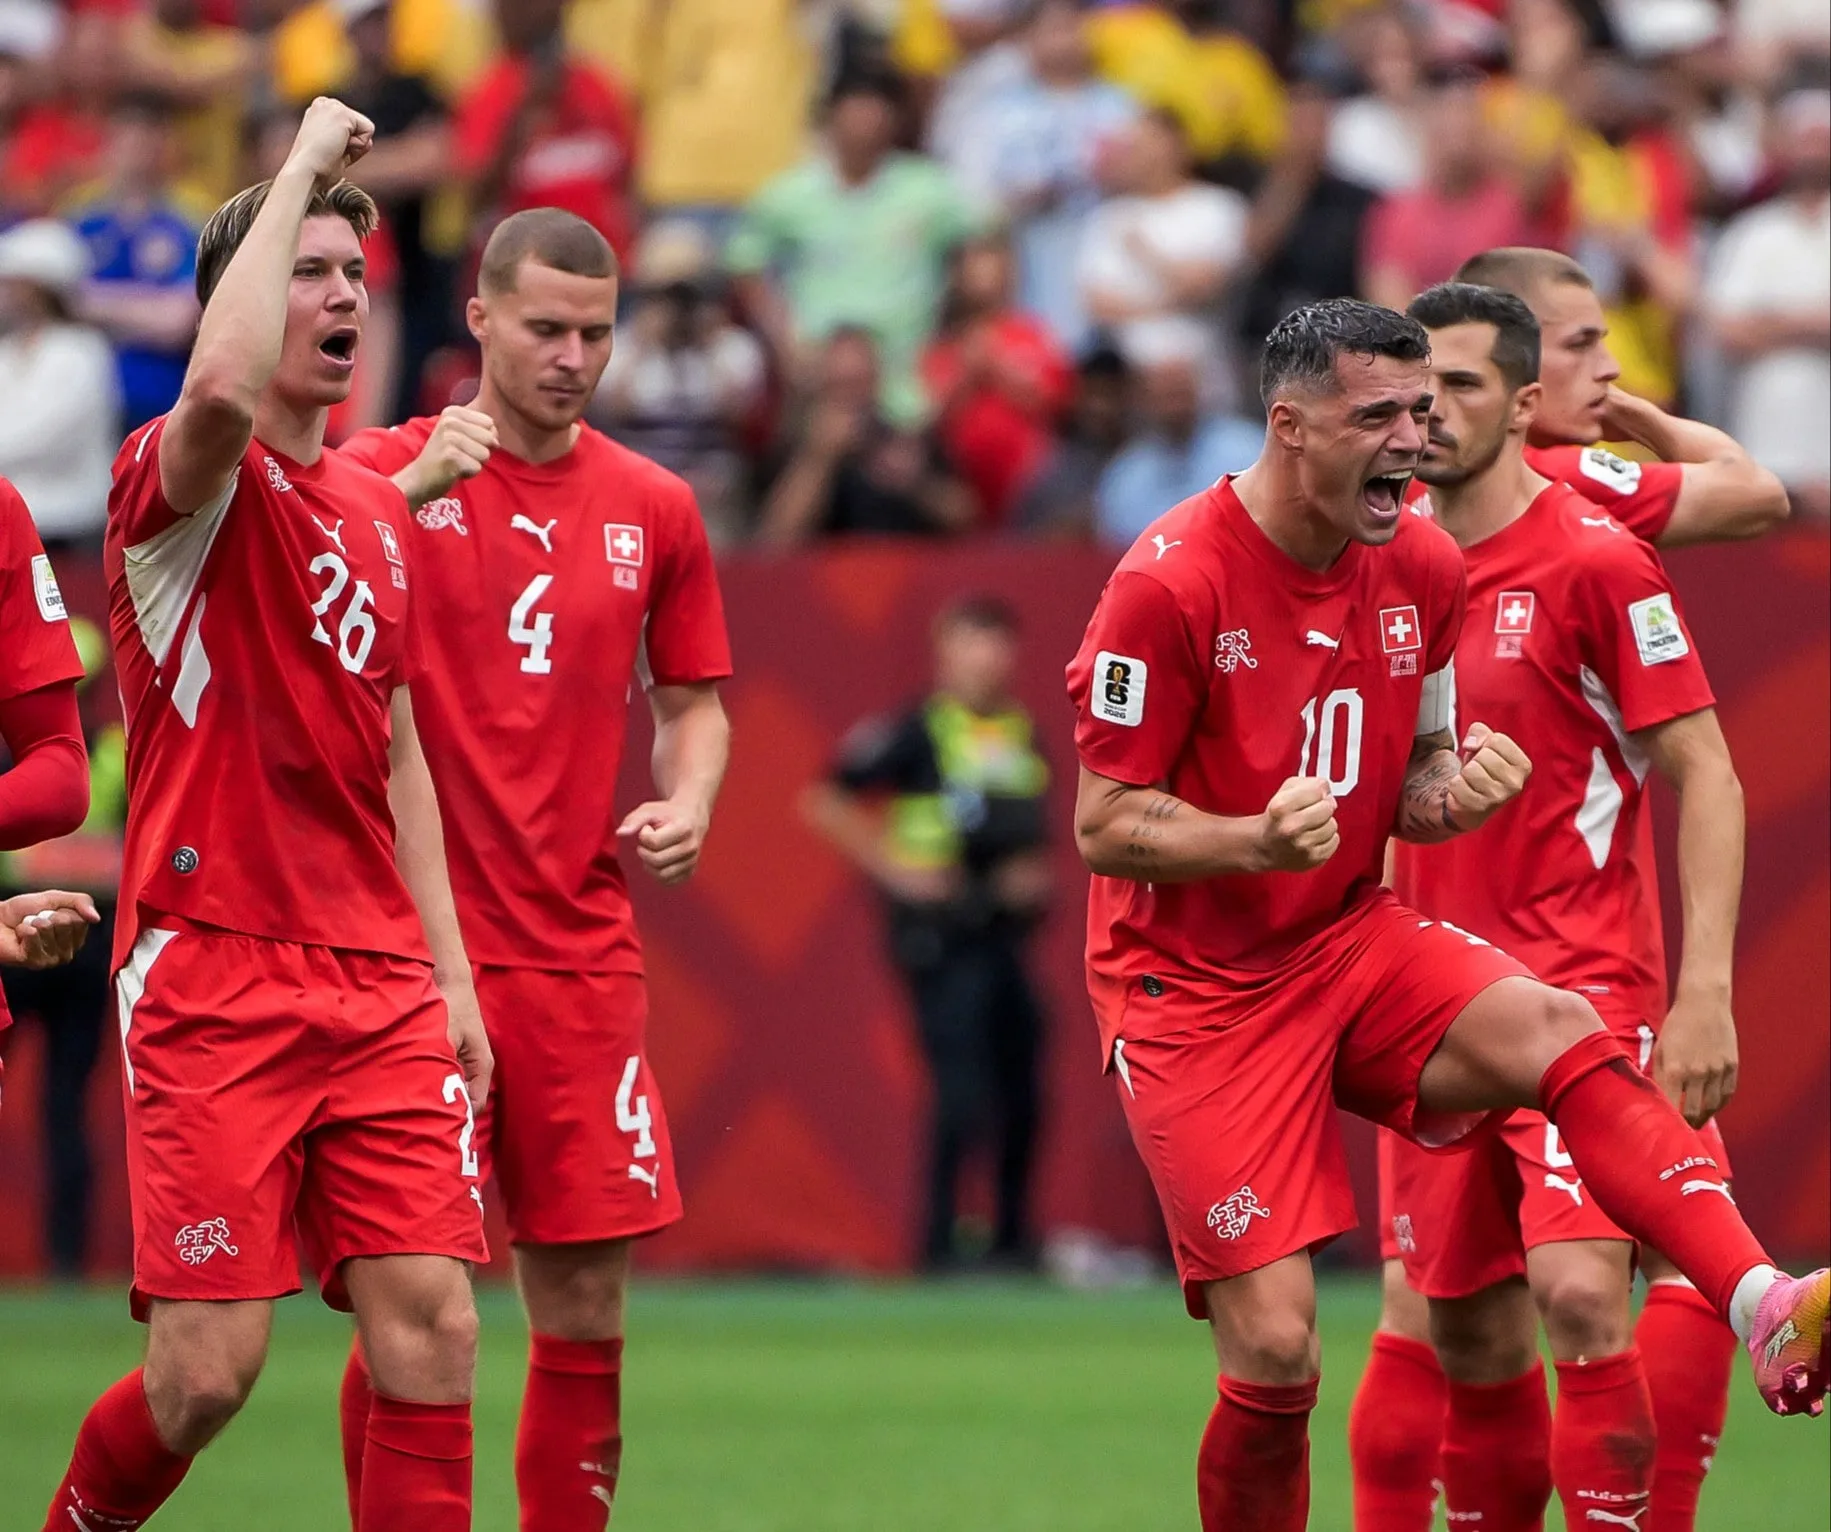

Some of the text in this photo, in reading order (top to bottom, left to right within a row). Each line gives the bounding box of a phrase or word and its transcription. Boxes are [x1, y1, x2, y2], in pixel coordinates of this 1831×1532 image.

[308, 551, 377, 675] 26
[507, 574, 554, 674] 4
[1104, 707, 1127, 720] 2026
[1298, 687, 1364, 797] 10
[614, 1055, 656, 1159] 4
[1658, 1156, 1718, 1181] suiss
